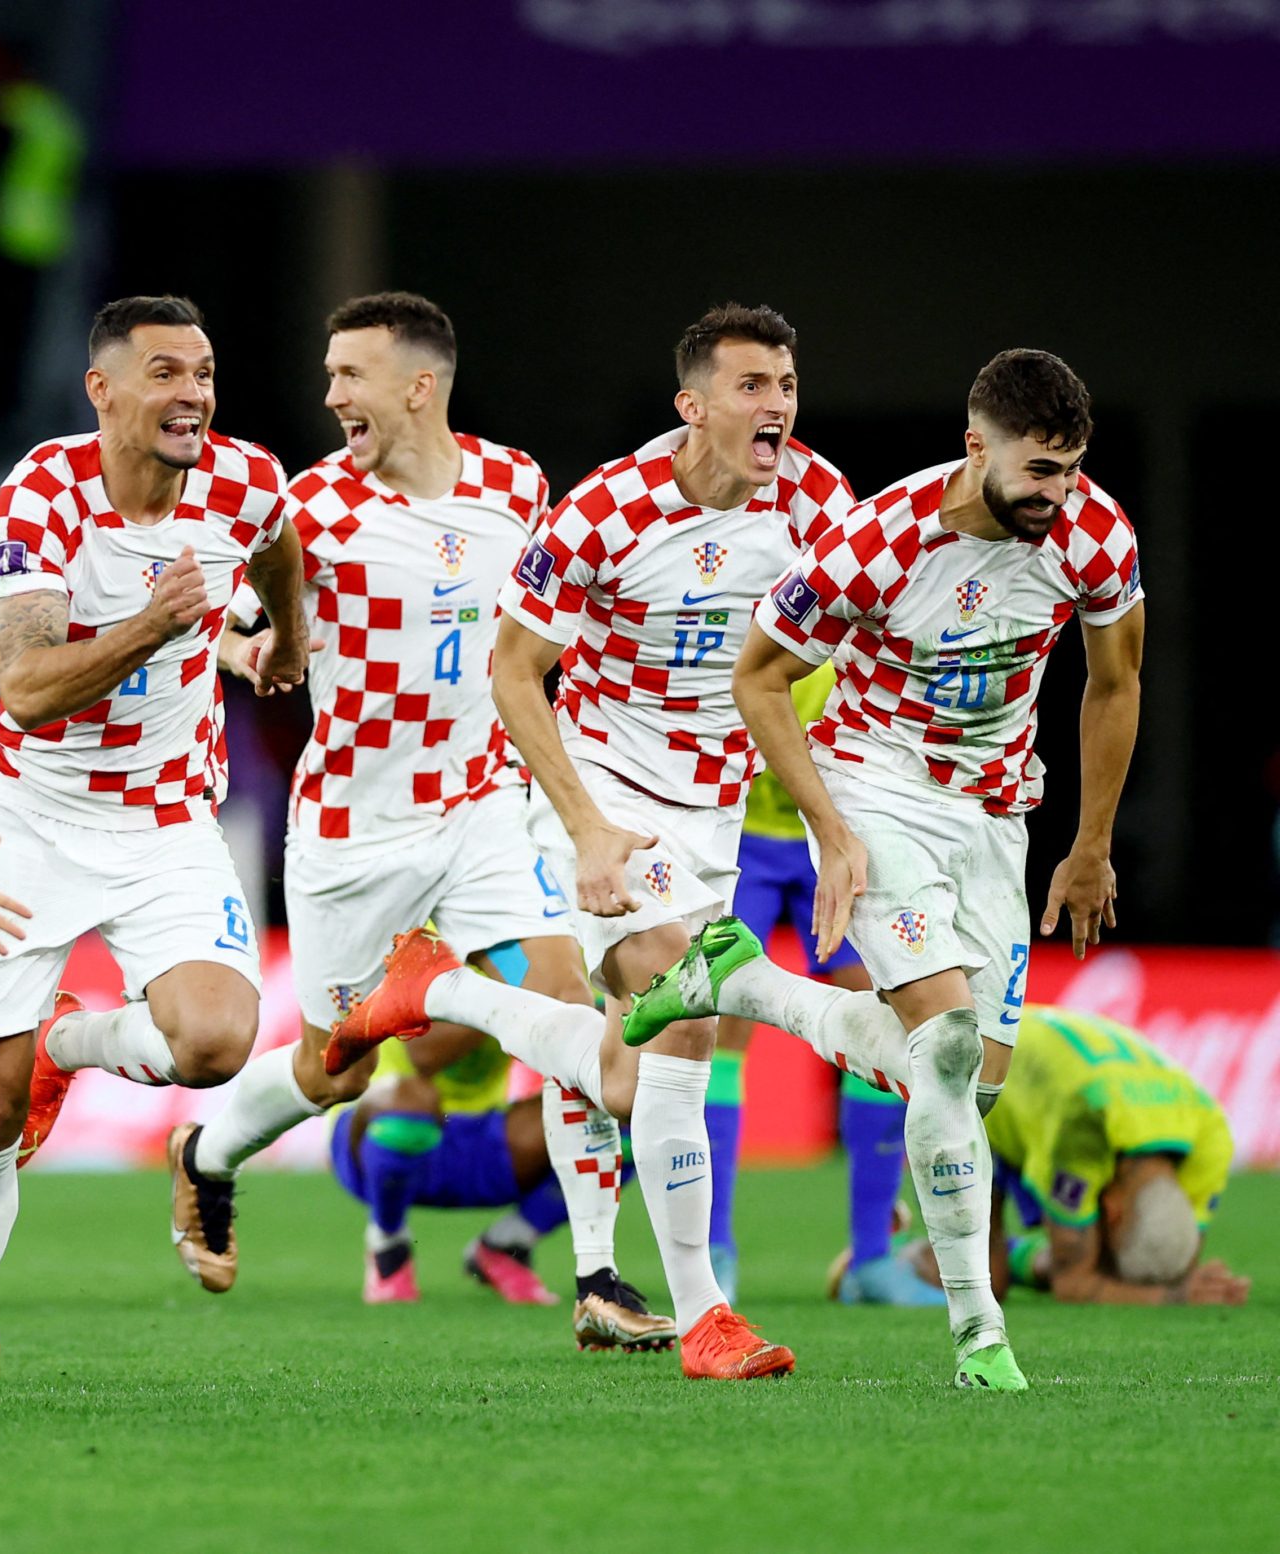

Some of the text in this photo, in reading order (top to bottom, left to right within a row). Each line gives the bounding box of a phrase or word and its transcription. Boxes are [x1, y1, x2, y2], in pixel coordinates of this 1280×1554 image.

[434, 629, 462, 685] 4
[666, 630, 725, 668] 17
[923, 666, 987, 709] 20
[223, 895, 248, 946] 6
